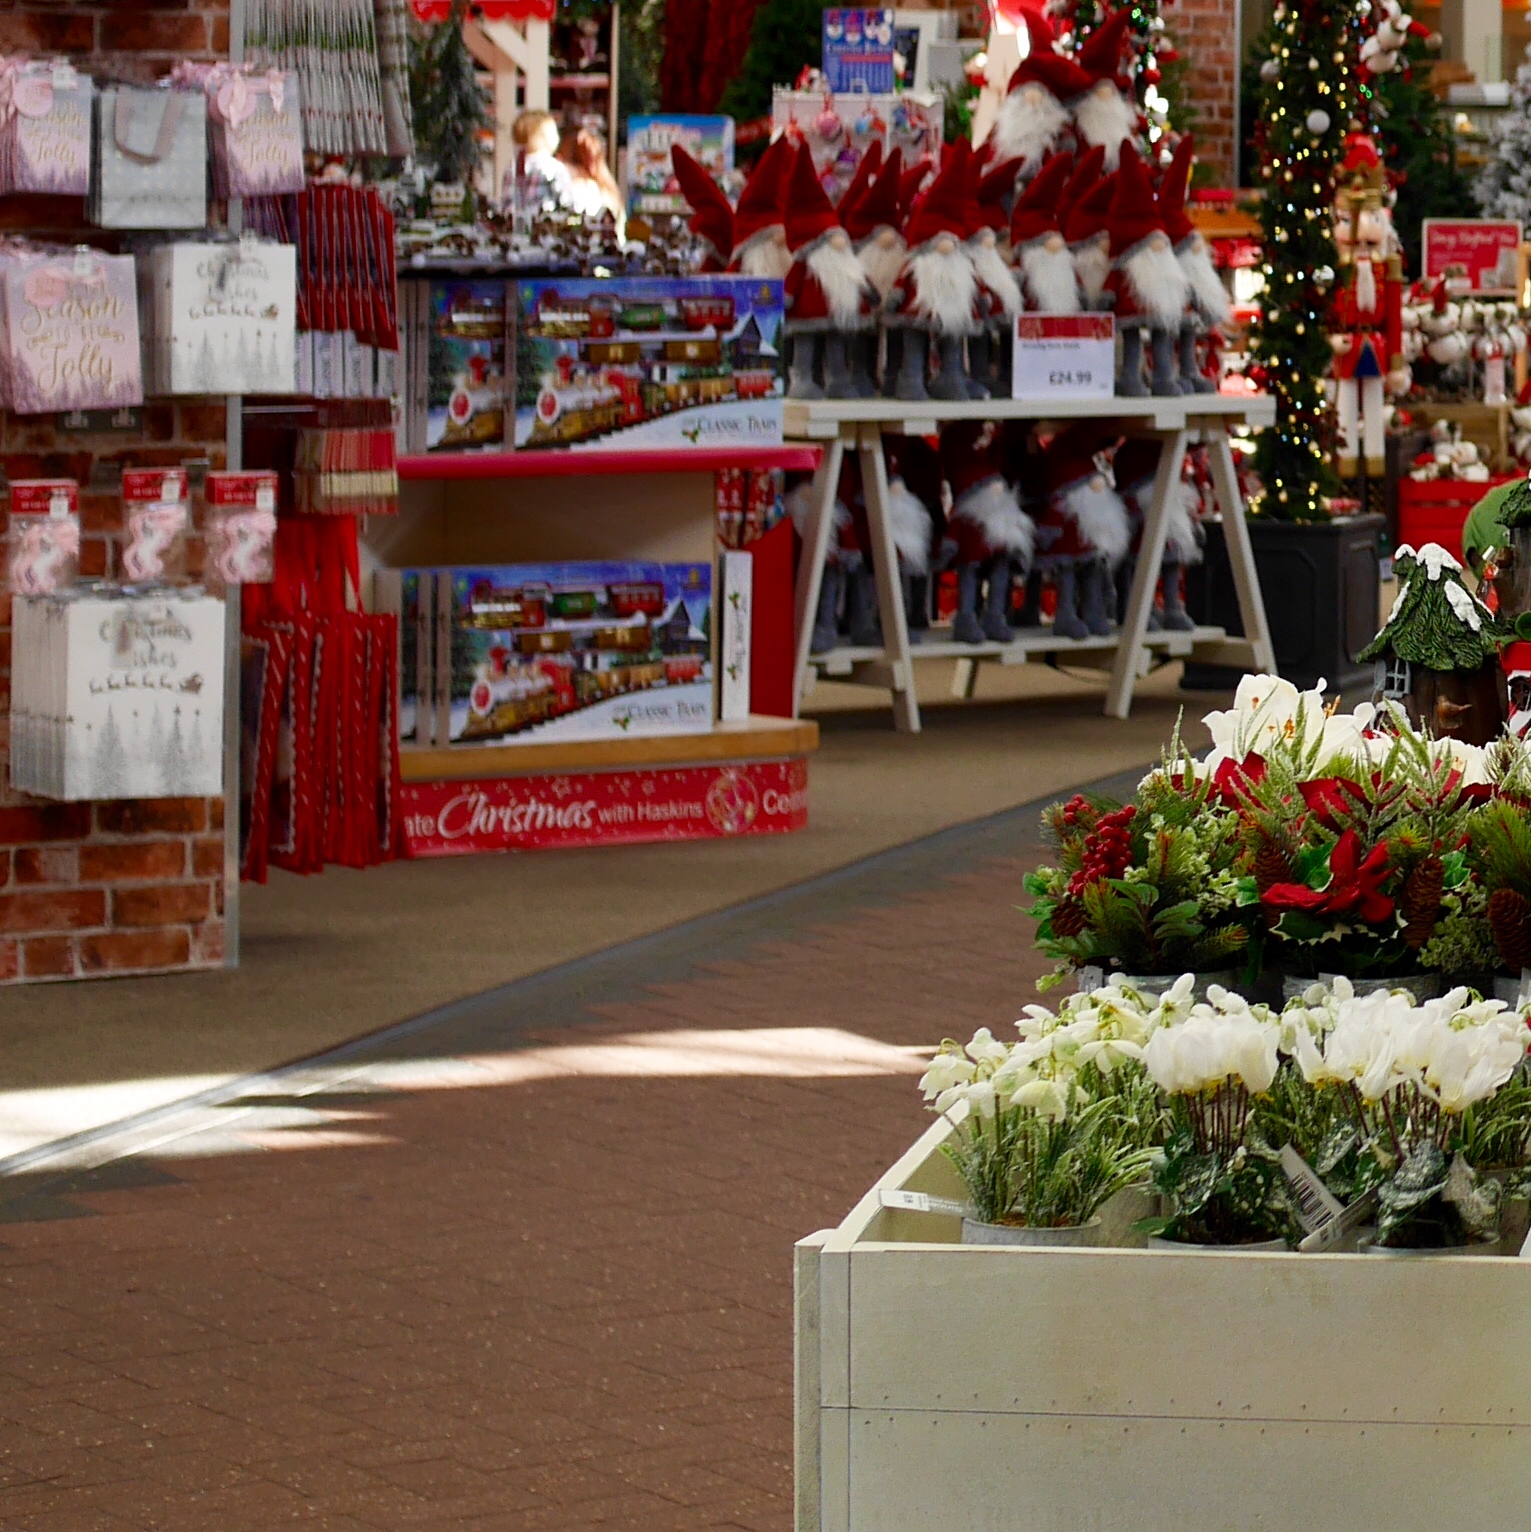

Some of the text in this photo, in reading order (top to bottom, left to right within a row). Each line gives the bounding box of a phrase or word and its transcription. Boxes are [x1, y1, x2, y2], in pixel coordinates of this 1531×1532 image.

[437, 790, 597, 839] Christmas
[598, 802, 634, 824] with
[637, 798, 704, 822] Haskins
